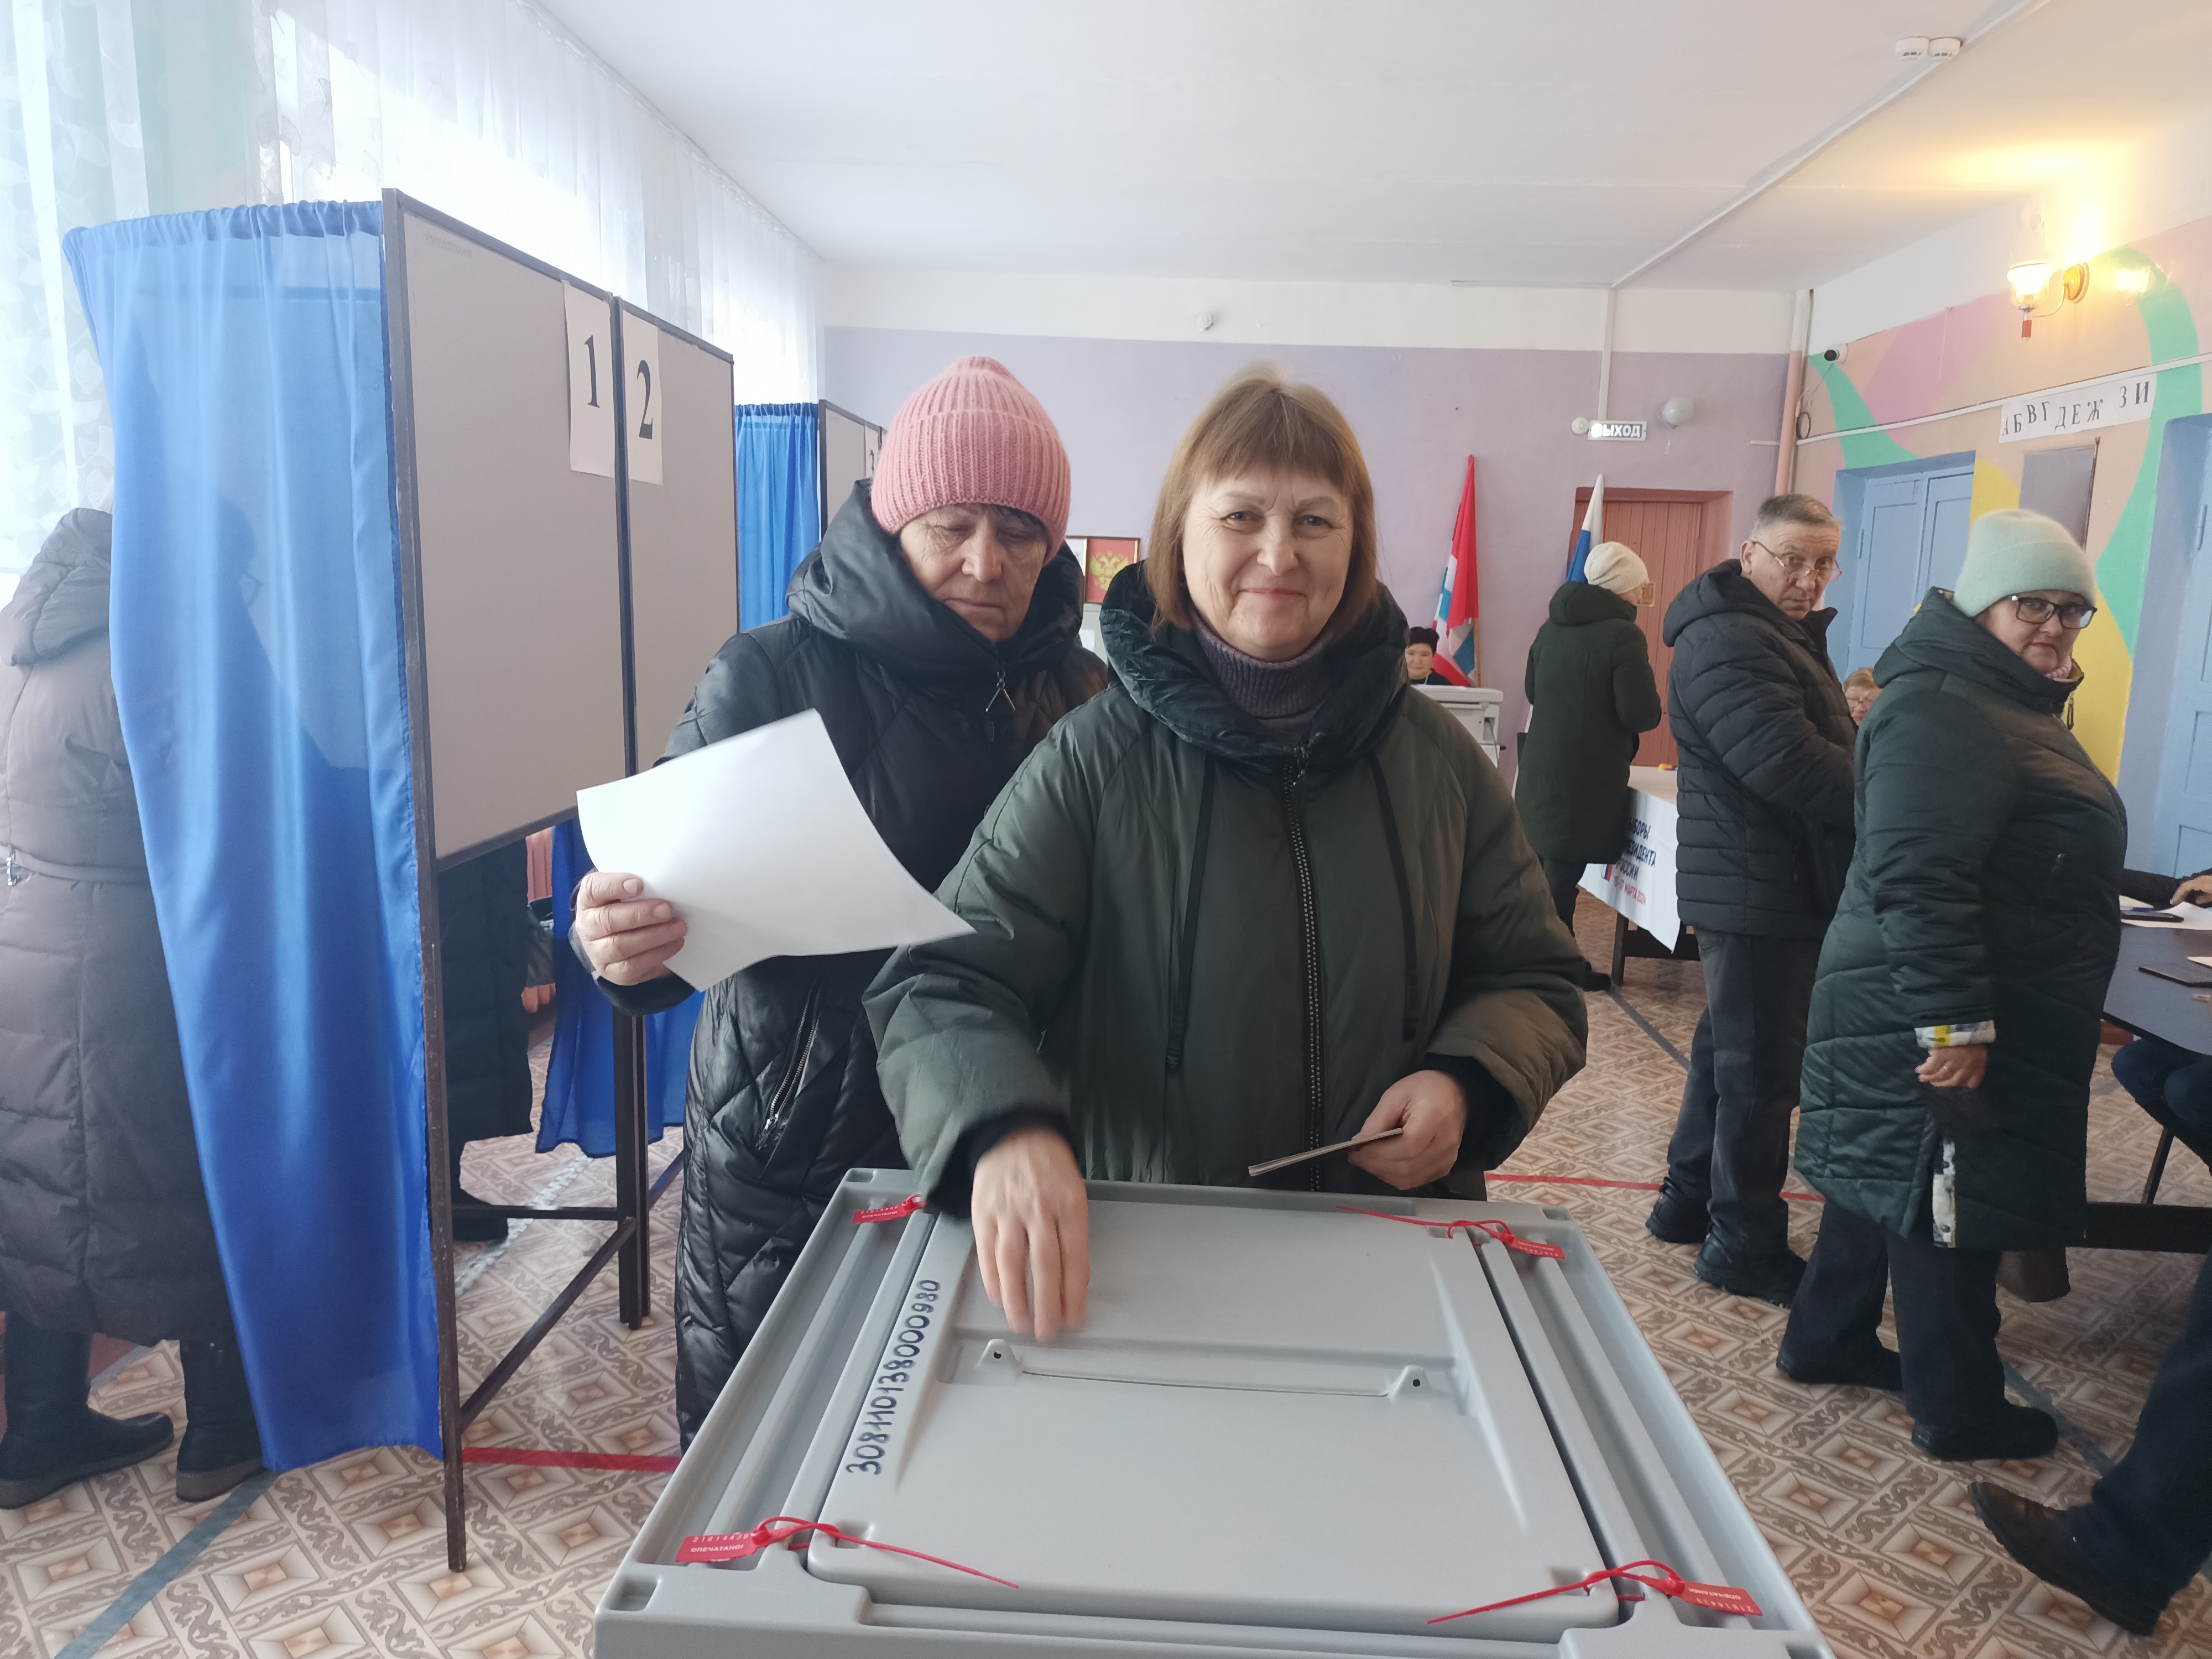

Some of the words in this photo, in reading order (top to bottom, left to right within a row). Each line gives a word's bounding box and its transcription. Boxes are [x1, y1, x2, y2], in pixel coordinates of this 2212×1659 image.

[584, 335, 600, 409] 1
[637, 359, 653, 440] 2
[1591, 424, 1640, 437] ЫХОД
[1627, 839, 1656, 867] ЕЗИДЕНТА
[1631, 817, 1651, 841] БОРЫ
[846, 1280, 941, 1475] 308110138000980
